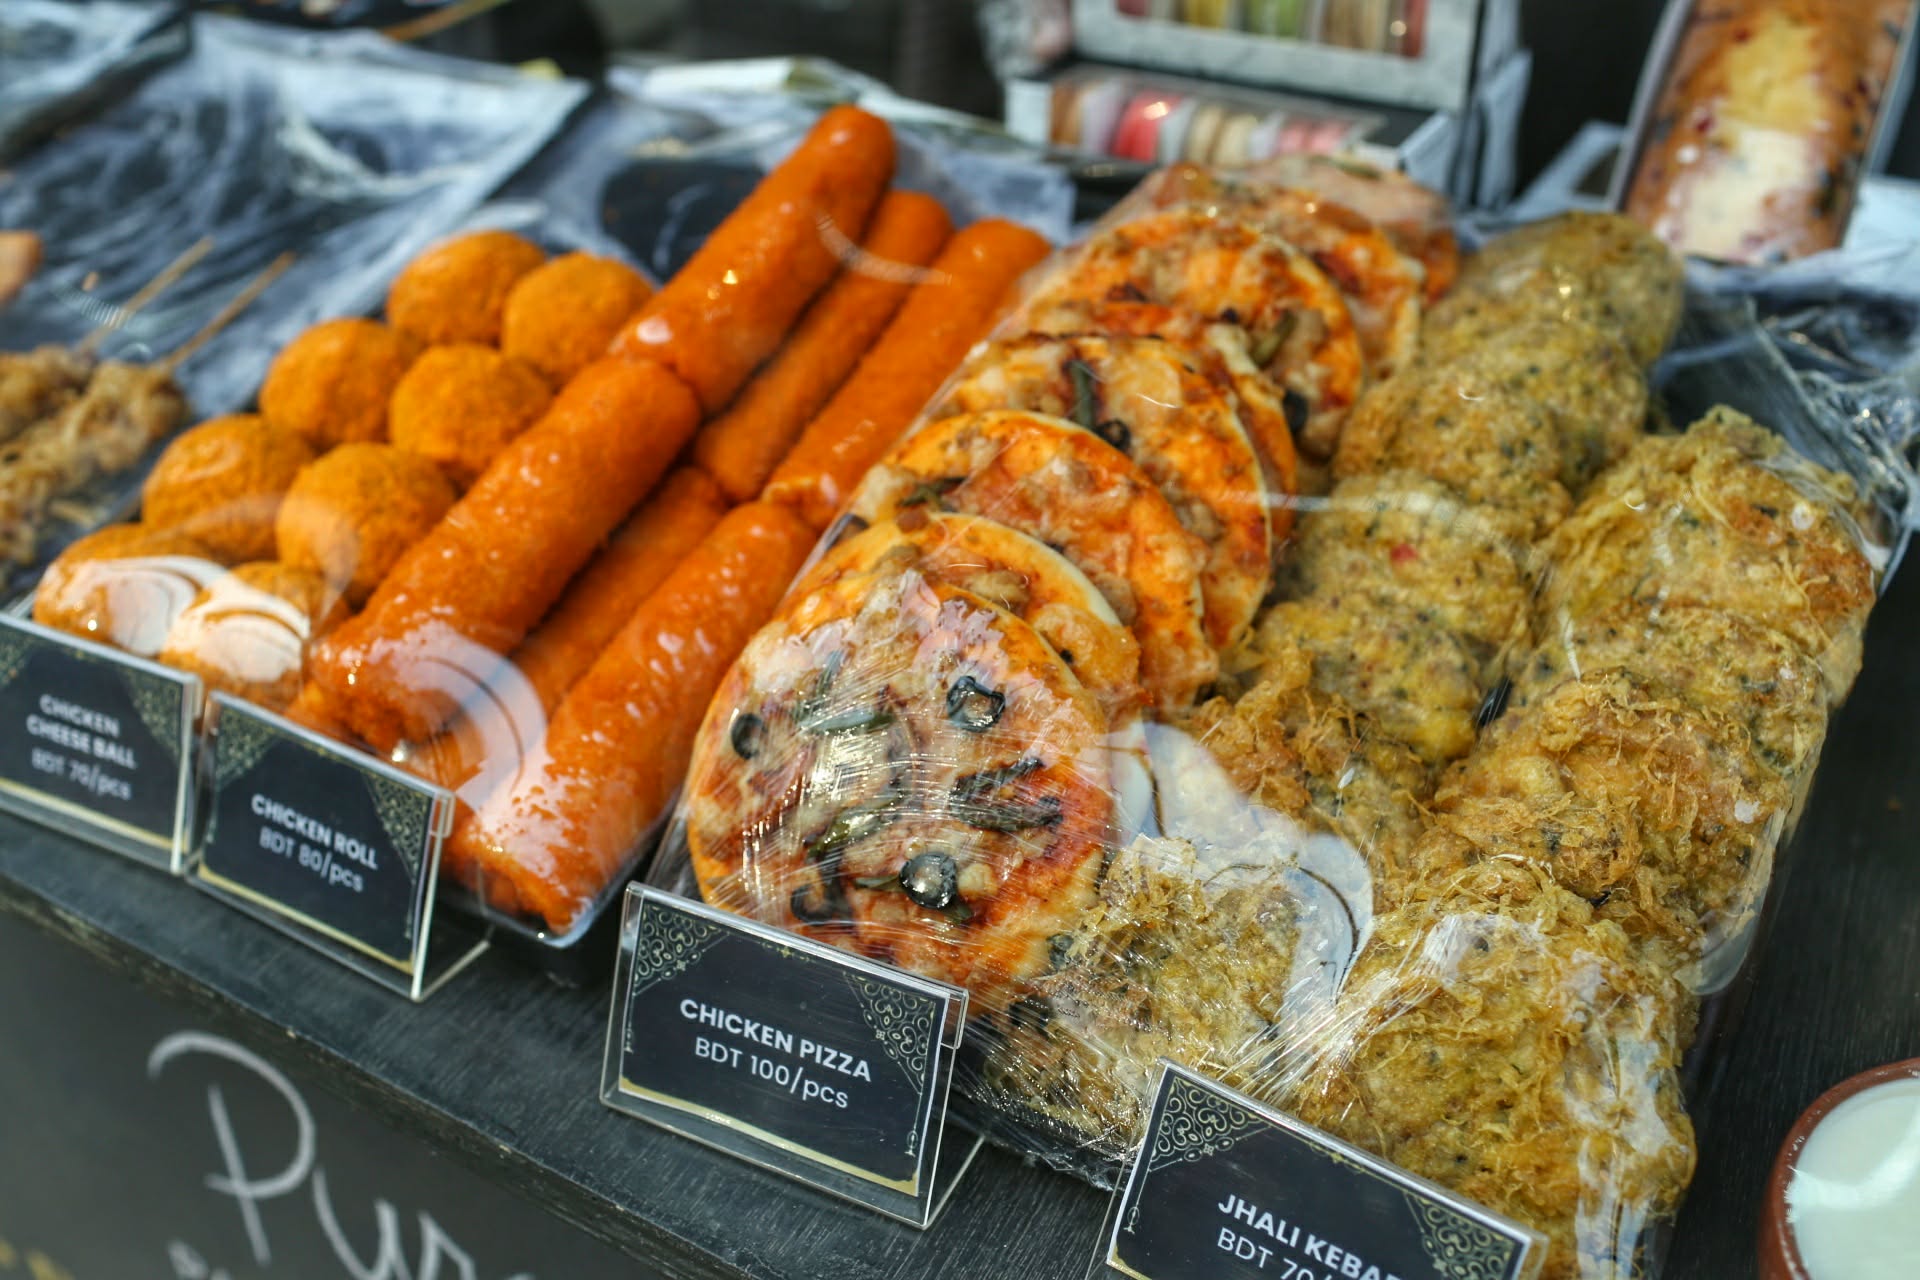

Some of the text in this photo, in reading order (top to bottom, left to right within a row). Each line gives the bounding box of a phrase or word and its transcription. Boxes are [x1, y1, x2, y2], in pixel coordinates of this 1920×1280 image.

[26, 713, 138, 770] CHEESE BALL
[40, 694, 120, 738] CHICKEN
[31, 747, 132, 800] BDT 70/pcs
[251, 794, 378, 870] CHICKEN ROLL
[259, 826, 363, 892] BDT 80/pcs
[680, 999, 871, 1082] CHICKEN PIZZA
[695, 1036, 848, 1108] BDT 100/pcs
[1217, 1227, 1273, 1268] BDT
[1218, 1194, 1402, 1280] JHALI KEBA
